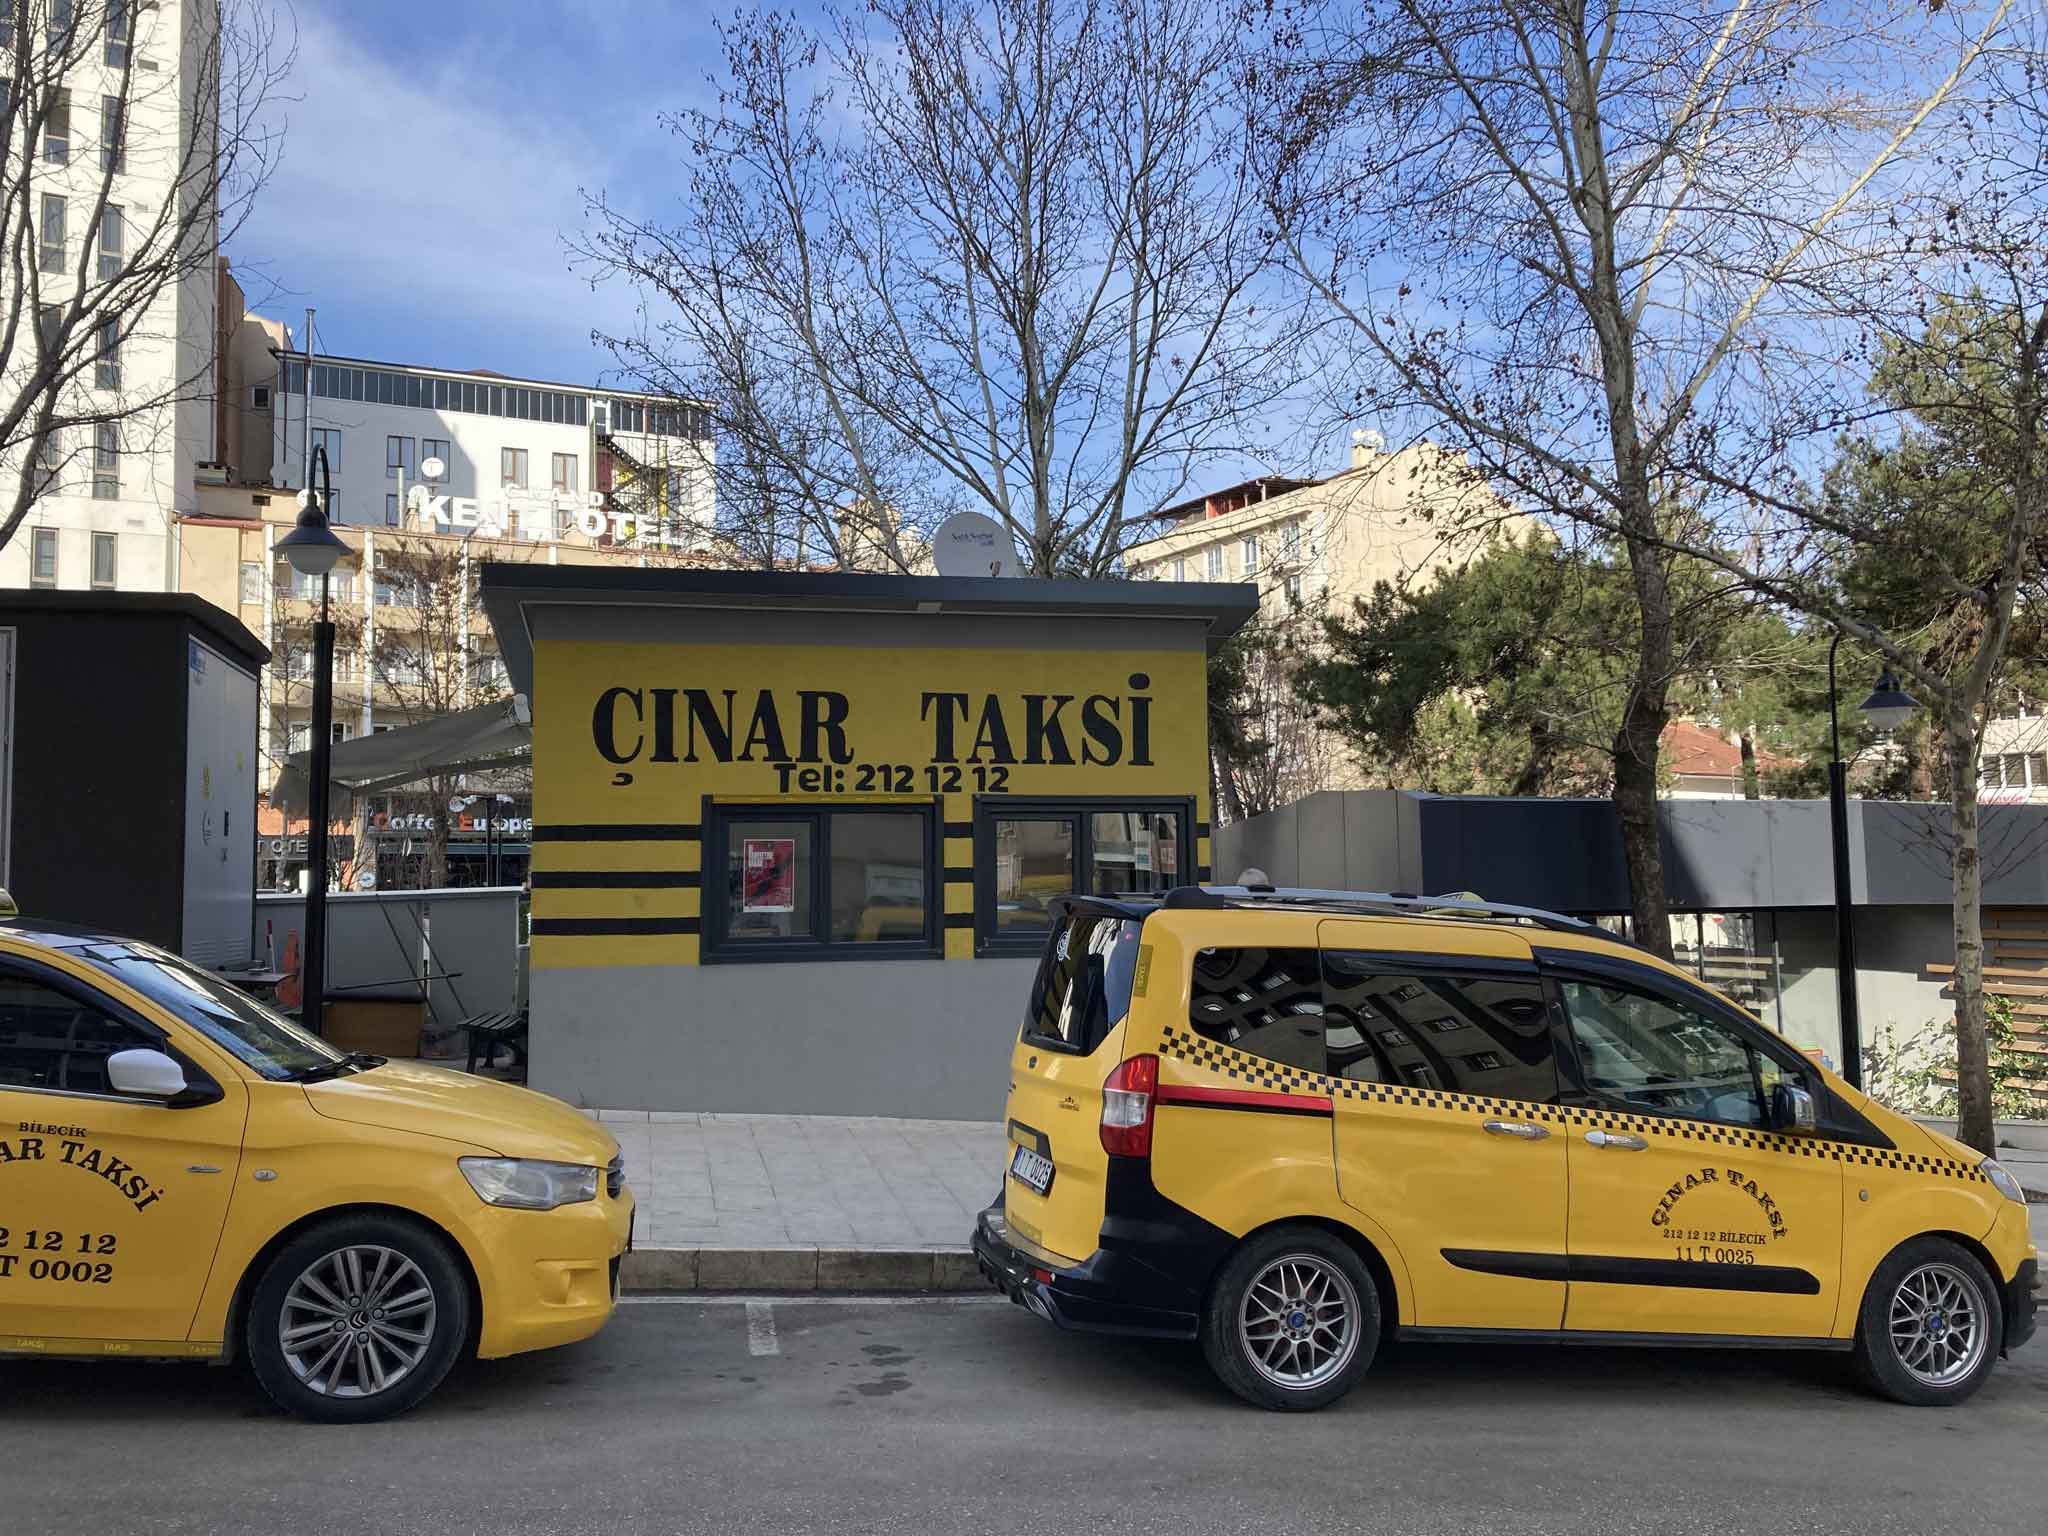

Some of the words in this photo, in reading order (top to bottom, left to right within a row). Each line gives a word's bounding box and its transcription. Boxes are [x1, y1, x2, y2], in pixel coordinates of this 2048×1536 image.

[592, 686, 854, 785] ÇINAR
[920, 673, 1154, 767] TAKSİ
[773, 763, 845, 793] Tel:
[855, 764, 914, 793] 212
[924, 765, 962, 793] 12
[971, 766, 1009, 793] 12
[18, 1120, 87, 1138] BİLECİK
[60, 1140, 164, 1213] TAKSİ
[1651, 1167, 1720, 1227] ÇINAR
[1727, 1168, 1788, 1240] TAKSİ
[24, 1230, 63, 1251] 12
[77, 1233, 117, 1255] 12
[1663, 1228, 1683, 1239] 212
[1688, 1230, 1700, 1240] 12
[1704, 1231, 1716, 1241] 12
[1676, 1245, 1693, 1261] 11
[1700, 1246, 1711, 1262] T
[1715, 1248, 1754, 1265] 0025
[29, 1259, 113, 1284] 0002
